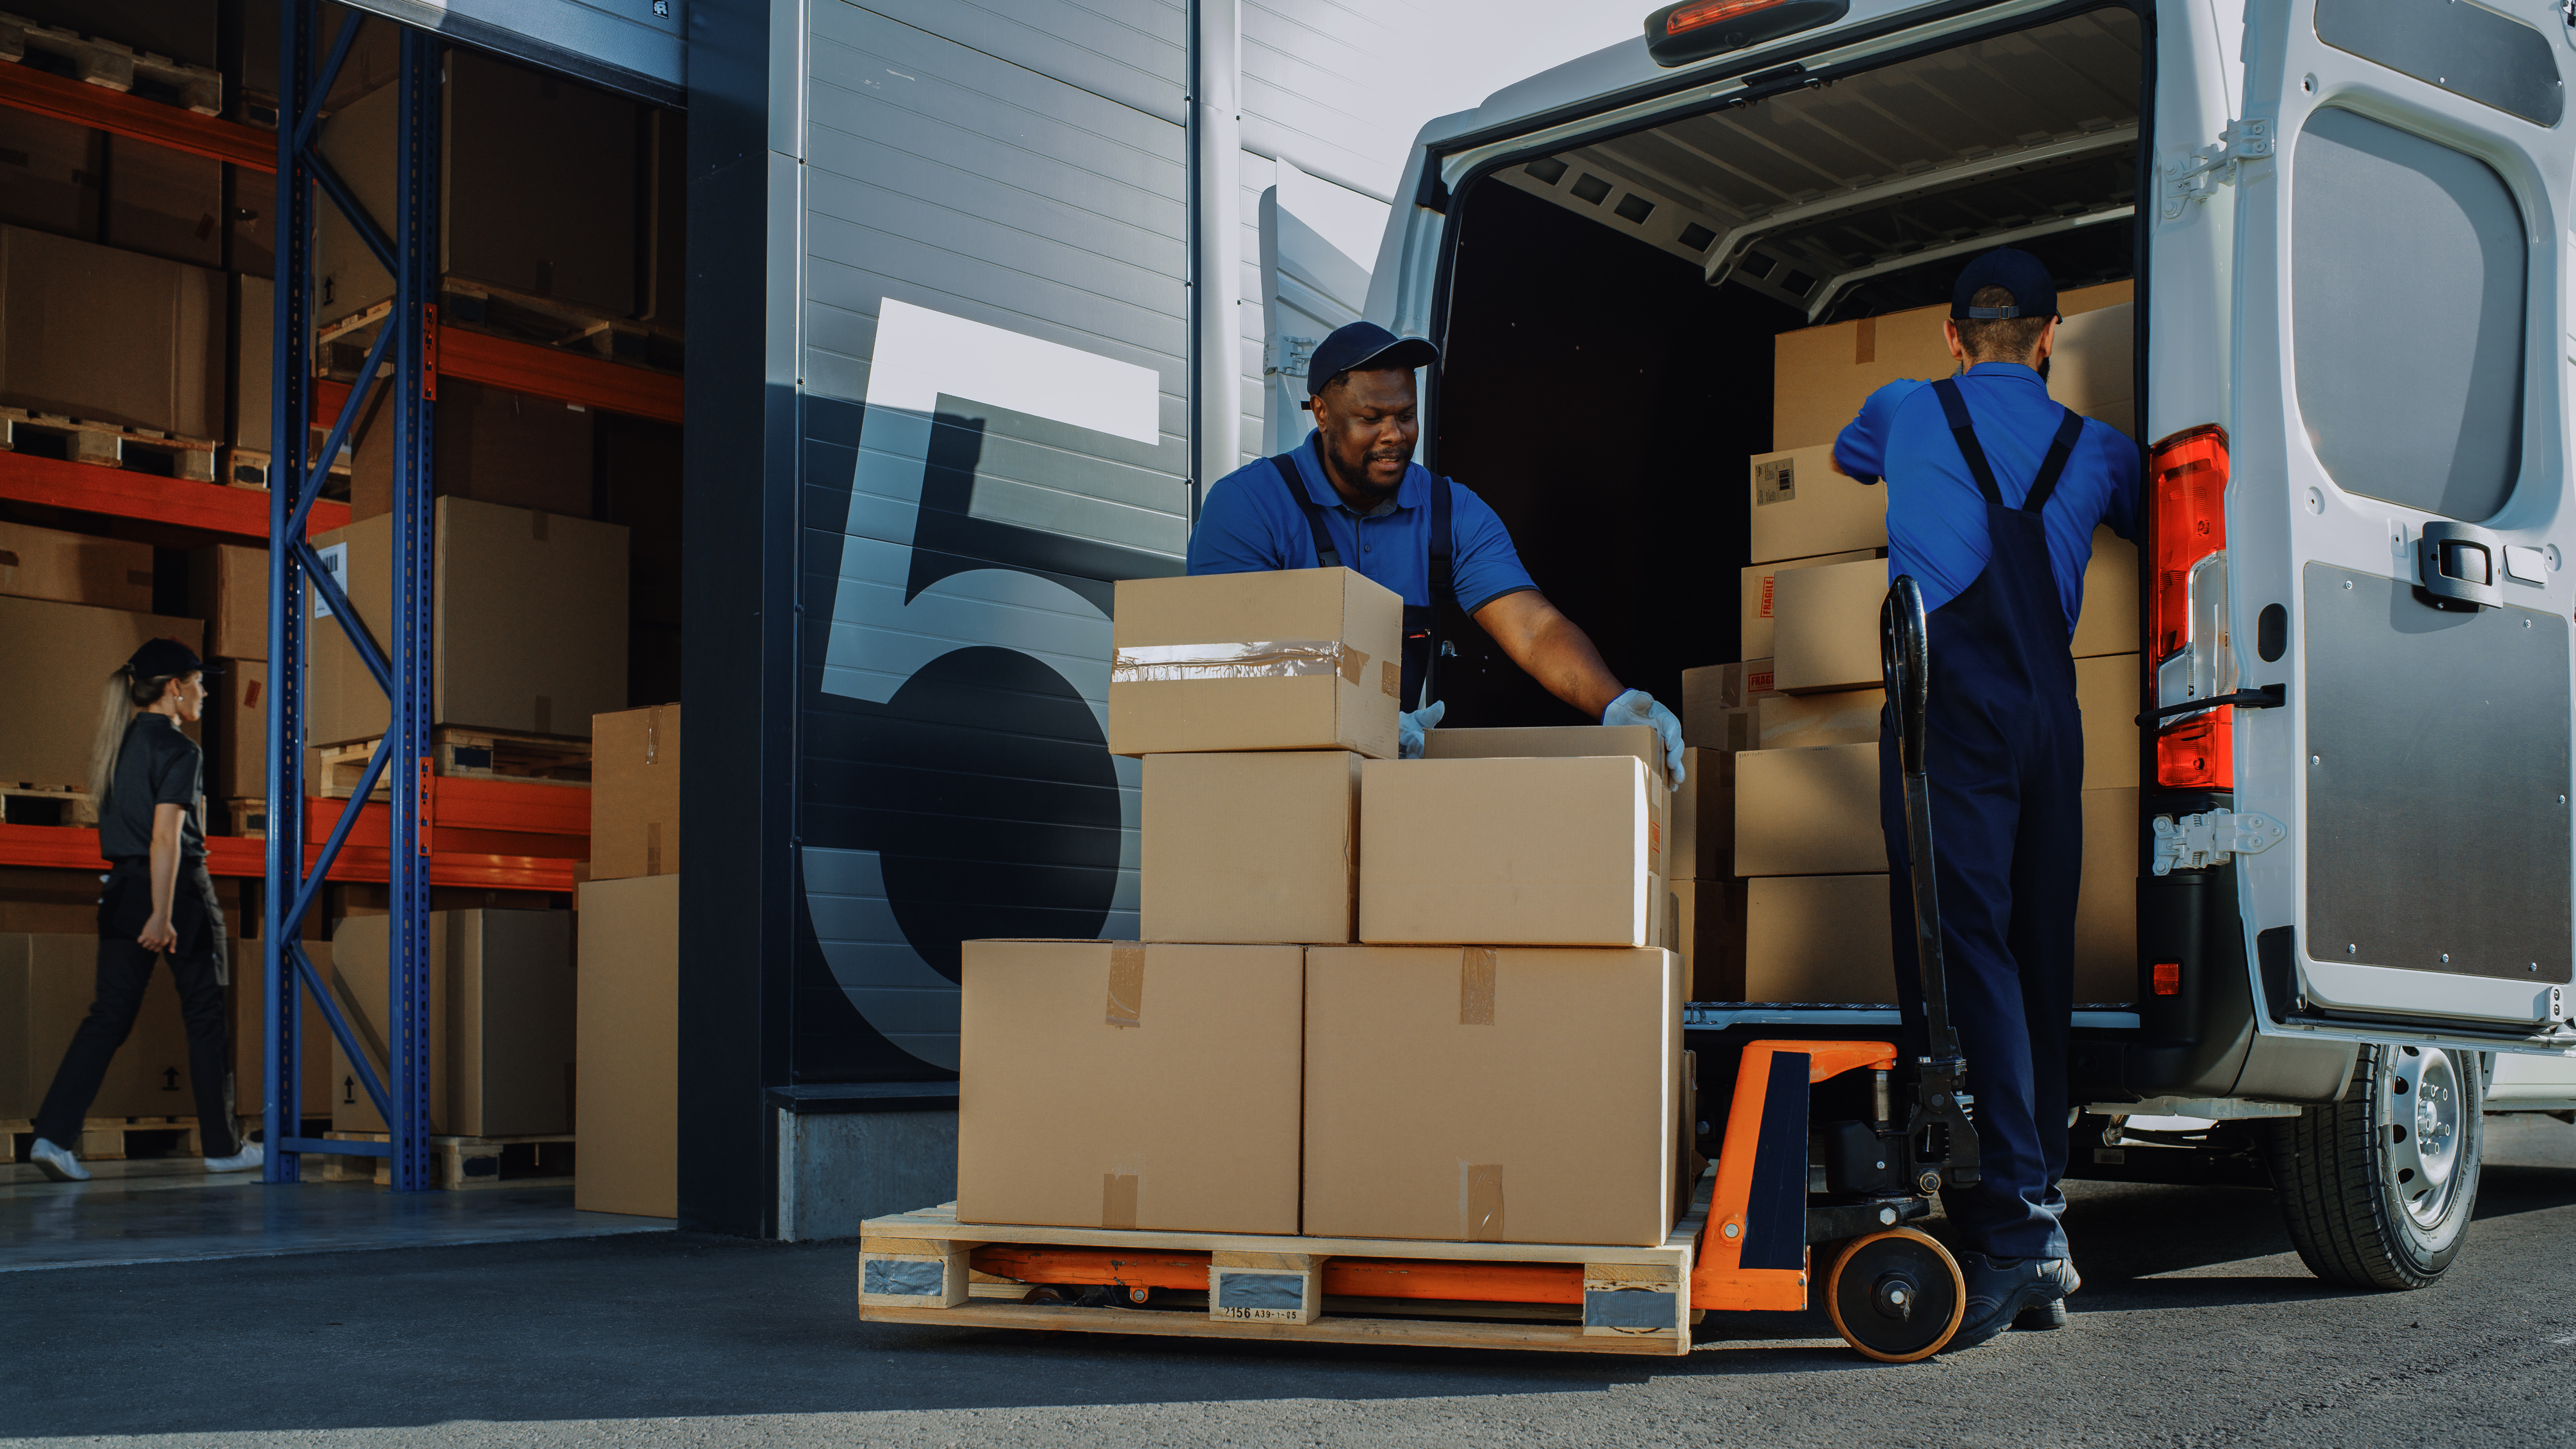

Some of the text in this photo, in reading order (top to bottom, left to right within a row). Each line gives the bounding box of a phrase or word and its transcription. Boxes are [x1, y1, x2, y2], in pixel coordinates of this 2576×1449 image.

[1762, 580, 1774, 614] FRAGILE
[802, 297, 1159, 1073] 5
[1751, 674, 1774, 686] FRAGI
